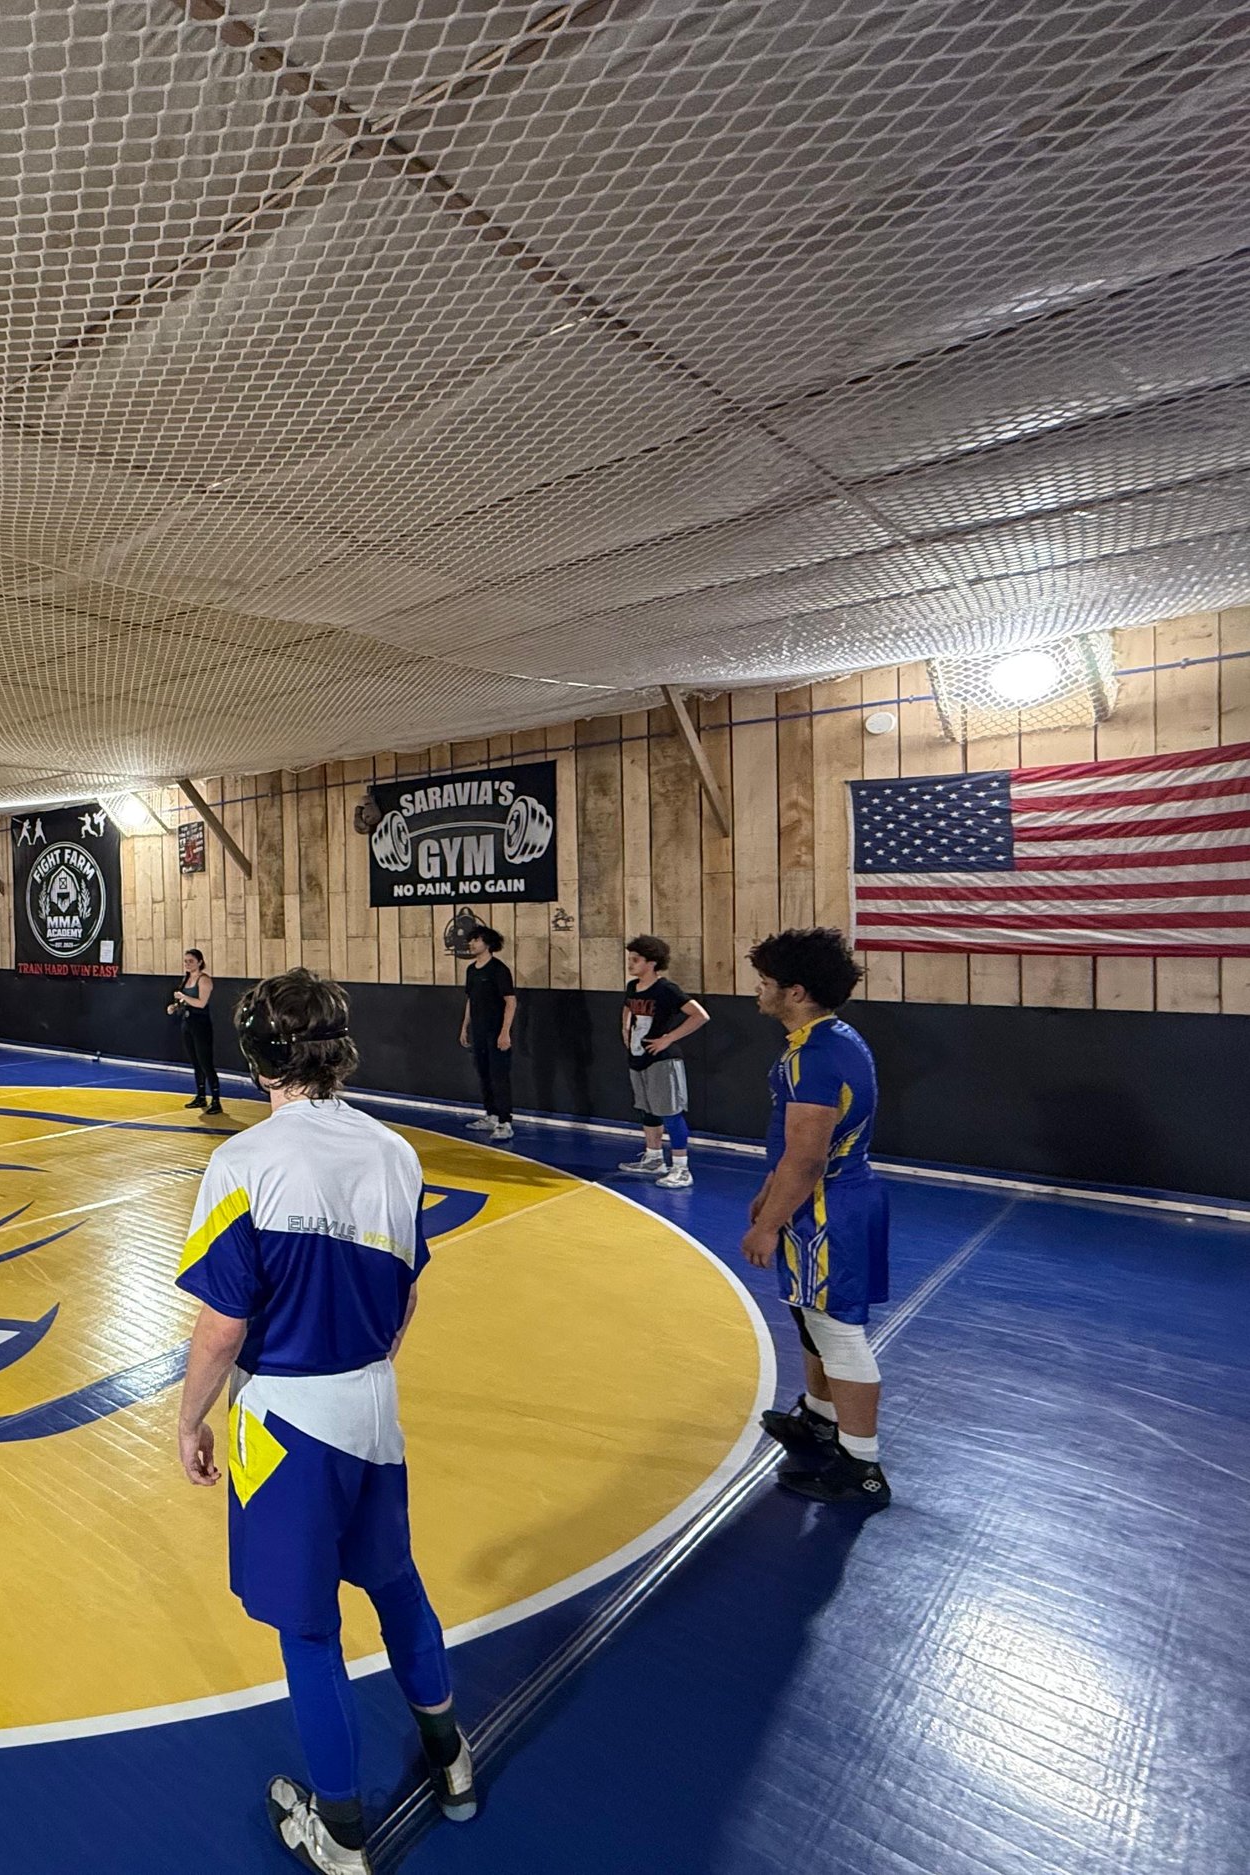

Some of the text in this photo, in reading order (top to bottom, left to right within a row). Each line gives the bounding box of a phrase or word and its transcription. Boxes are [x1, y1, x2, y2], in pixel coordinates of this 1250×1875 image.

[399, 780, 515, 817] SARAVIA'S
[418, 834, 495, 879] GYM
[33, 849, 95, 884] FIGHT FARM
[393, 878, 525, 897] NO PAIN, NO GAIN
[47, 915, 82, 928] MMA
[47, 928, 83, 938] ACADEMY
[18, 963, 119, 977] TRAIN HARD WIN EASY
